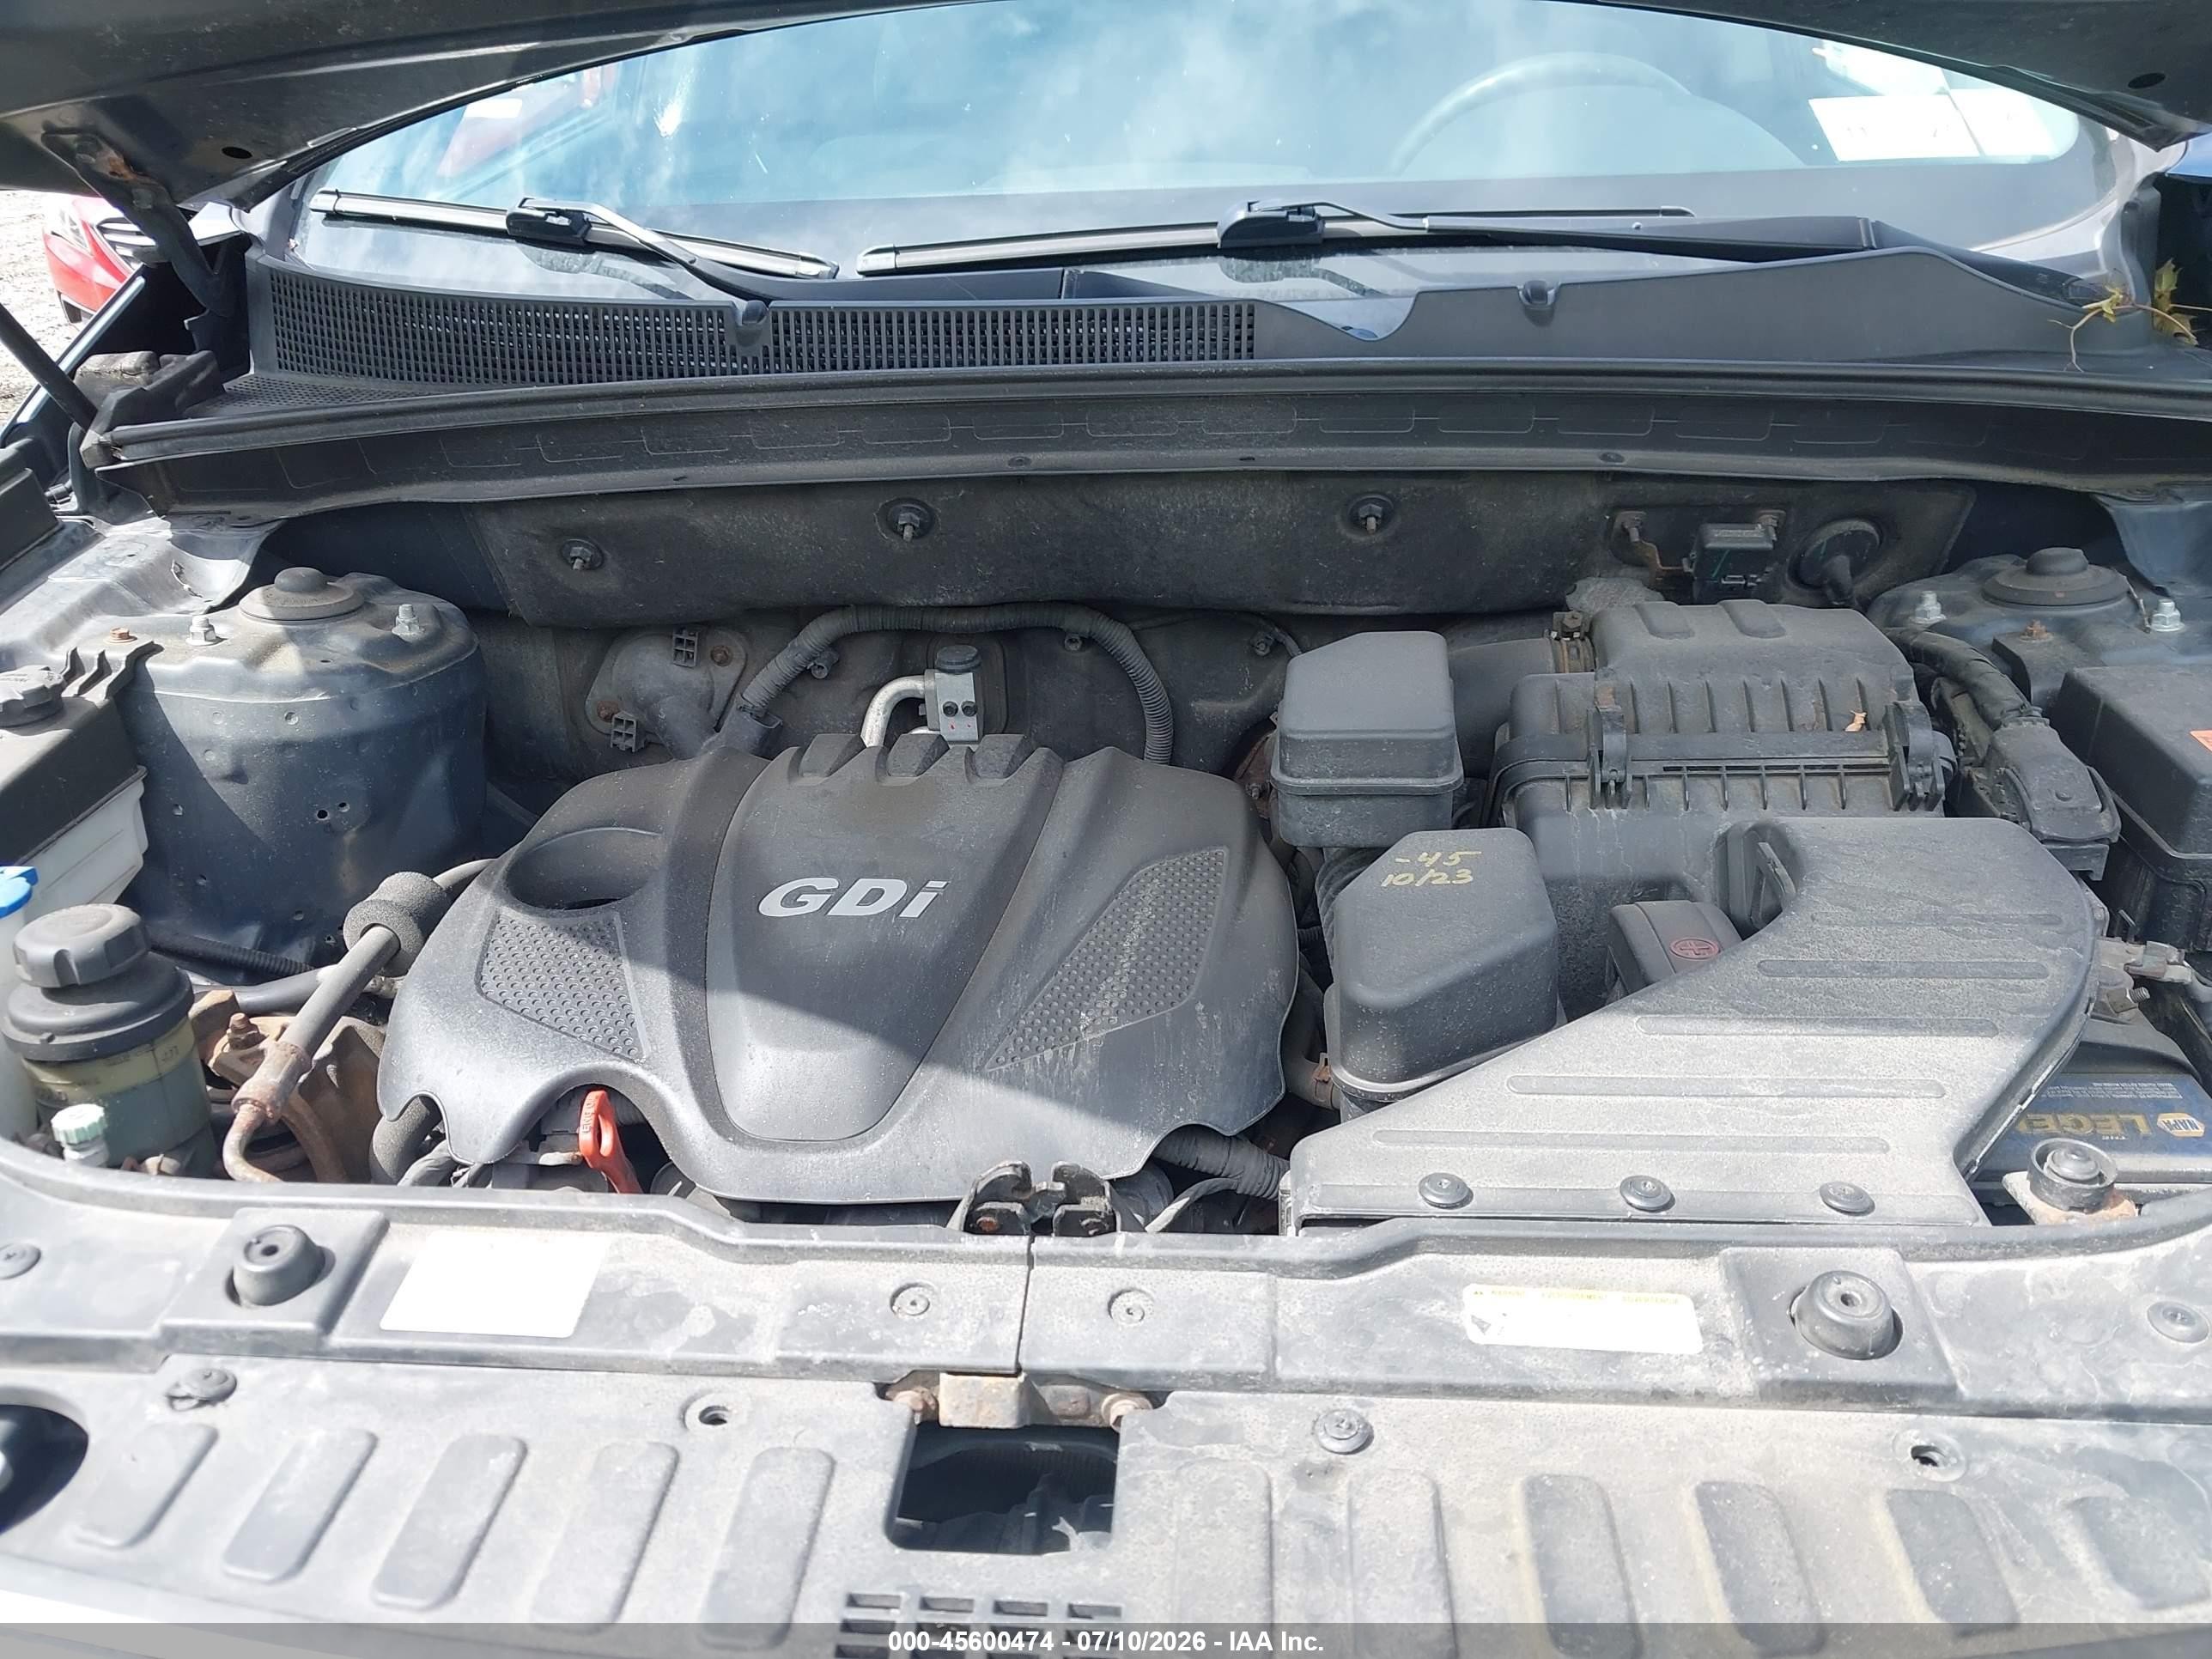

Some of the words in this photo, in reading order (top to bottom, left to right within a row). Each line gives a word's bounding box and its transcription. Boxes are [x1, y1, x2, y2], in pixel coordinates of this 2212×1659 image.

[1381, 868, 1474, 887] 10/23
[757, 876, 951, 918] GDi
[2015, 1113, 2151, 1135] LEGE
[2160, 1118, 2200, 1131] NAPA
